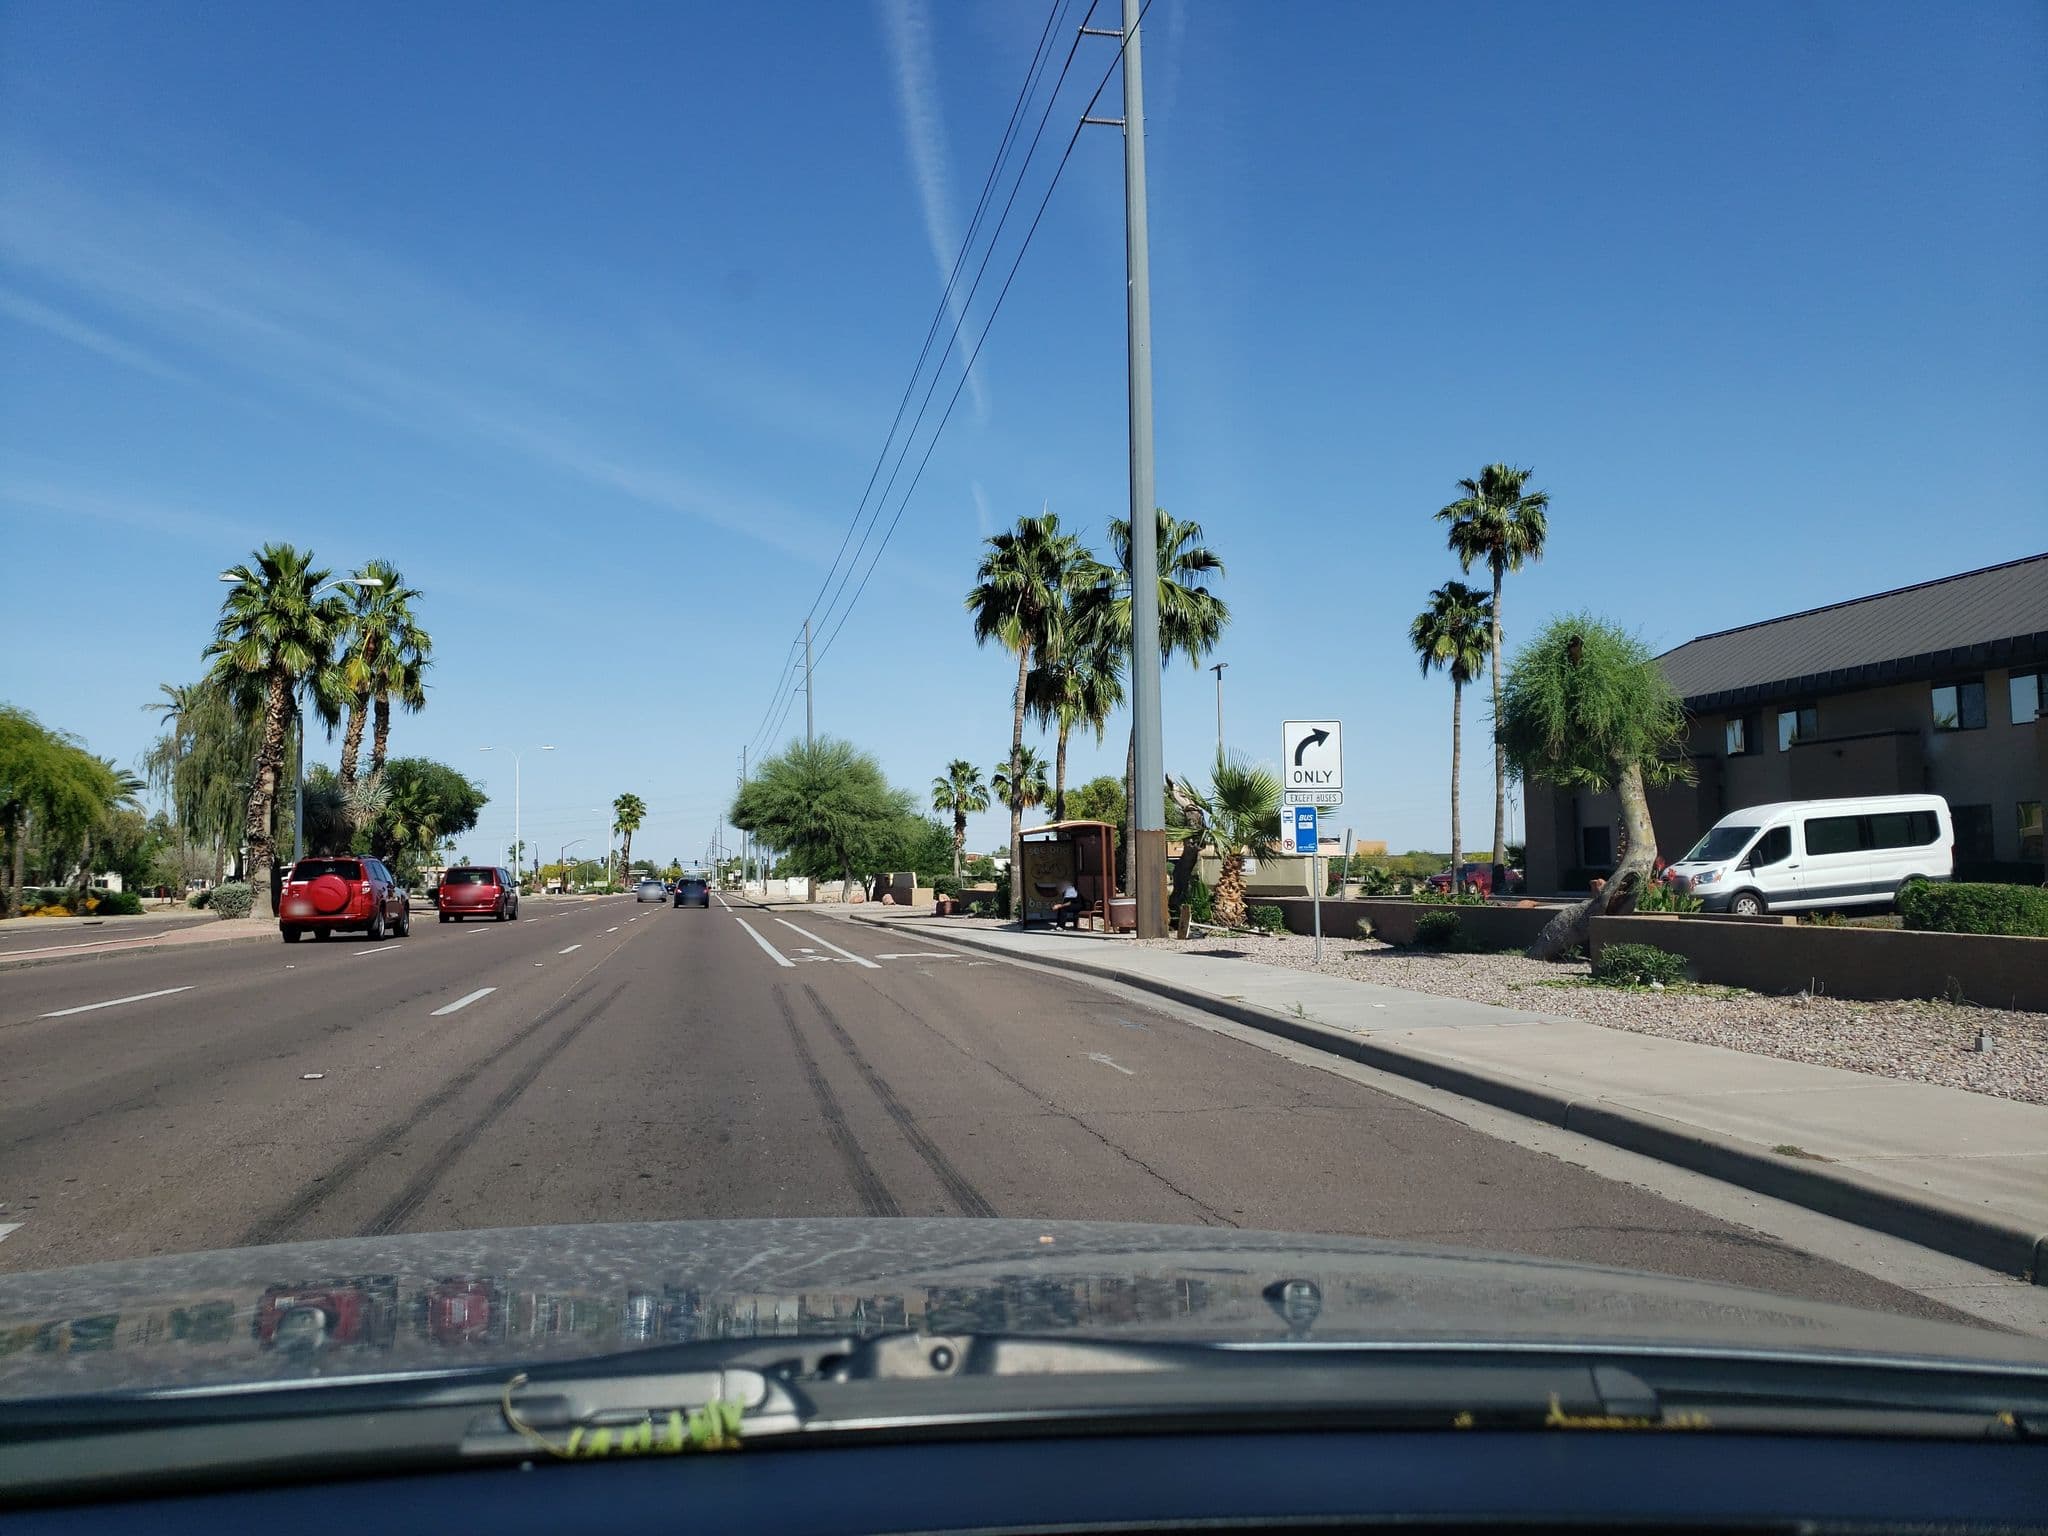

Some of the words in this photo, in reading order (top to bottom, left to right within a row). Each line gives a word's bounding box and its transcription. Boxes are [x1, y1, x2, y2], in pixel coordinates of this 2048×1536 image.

[1294, 770, 1333, 783] ONLY
[1290, 794, 1312, 802] EXCEPT
[1316, 794, 1337, 802] BUSES
[1299, 814, 1314, 822] BUS
